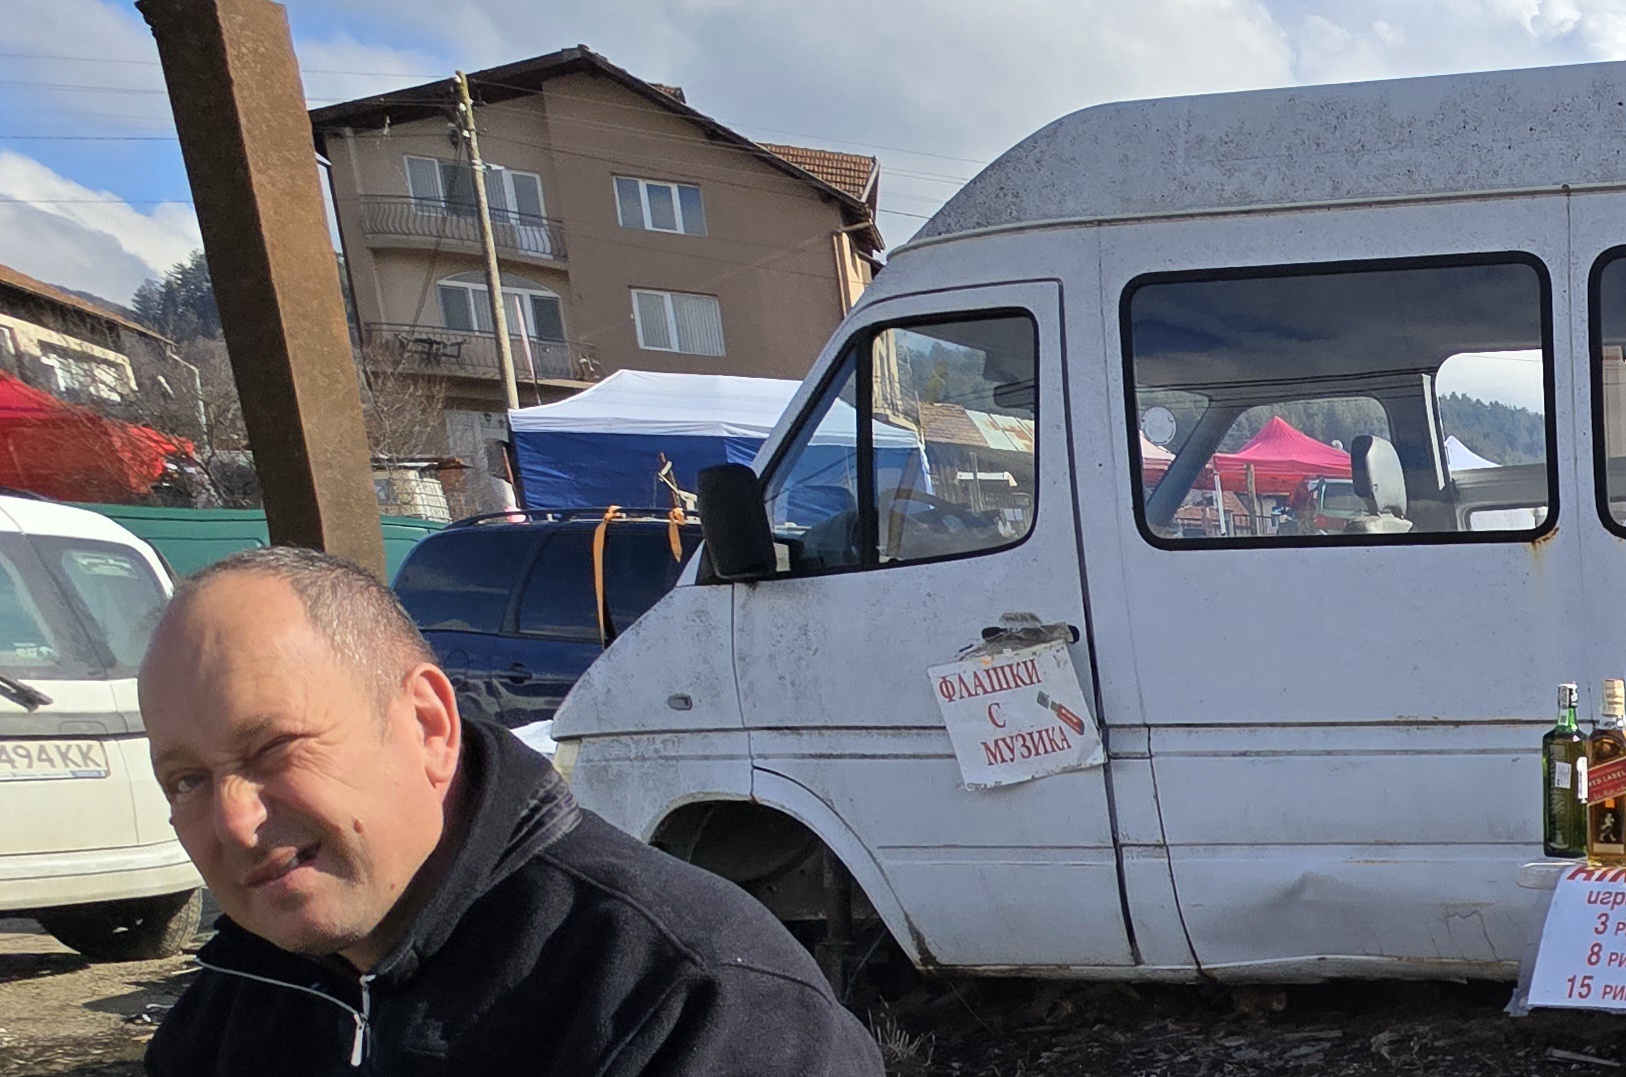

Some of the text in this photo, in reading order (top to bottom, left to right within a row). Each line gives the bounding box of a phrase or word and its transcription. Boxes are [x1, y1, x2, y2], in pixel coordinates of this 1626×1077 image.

[938, 658, 1042, 703] ФЛАШКИ
[987, 702, 1006, 728] С
[980, 725, 1072, 766] МУЗИКА
[1594, 913, 1610, 936] 3
[1587, 943, 1603, 967] 8
[1566, 975, 1594, 999] 15
